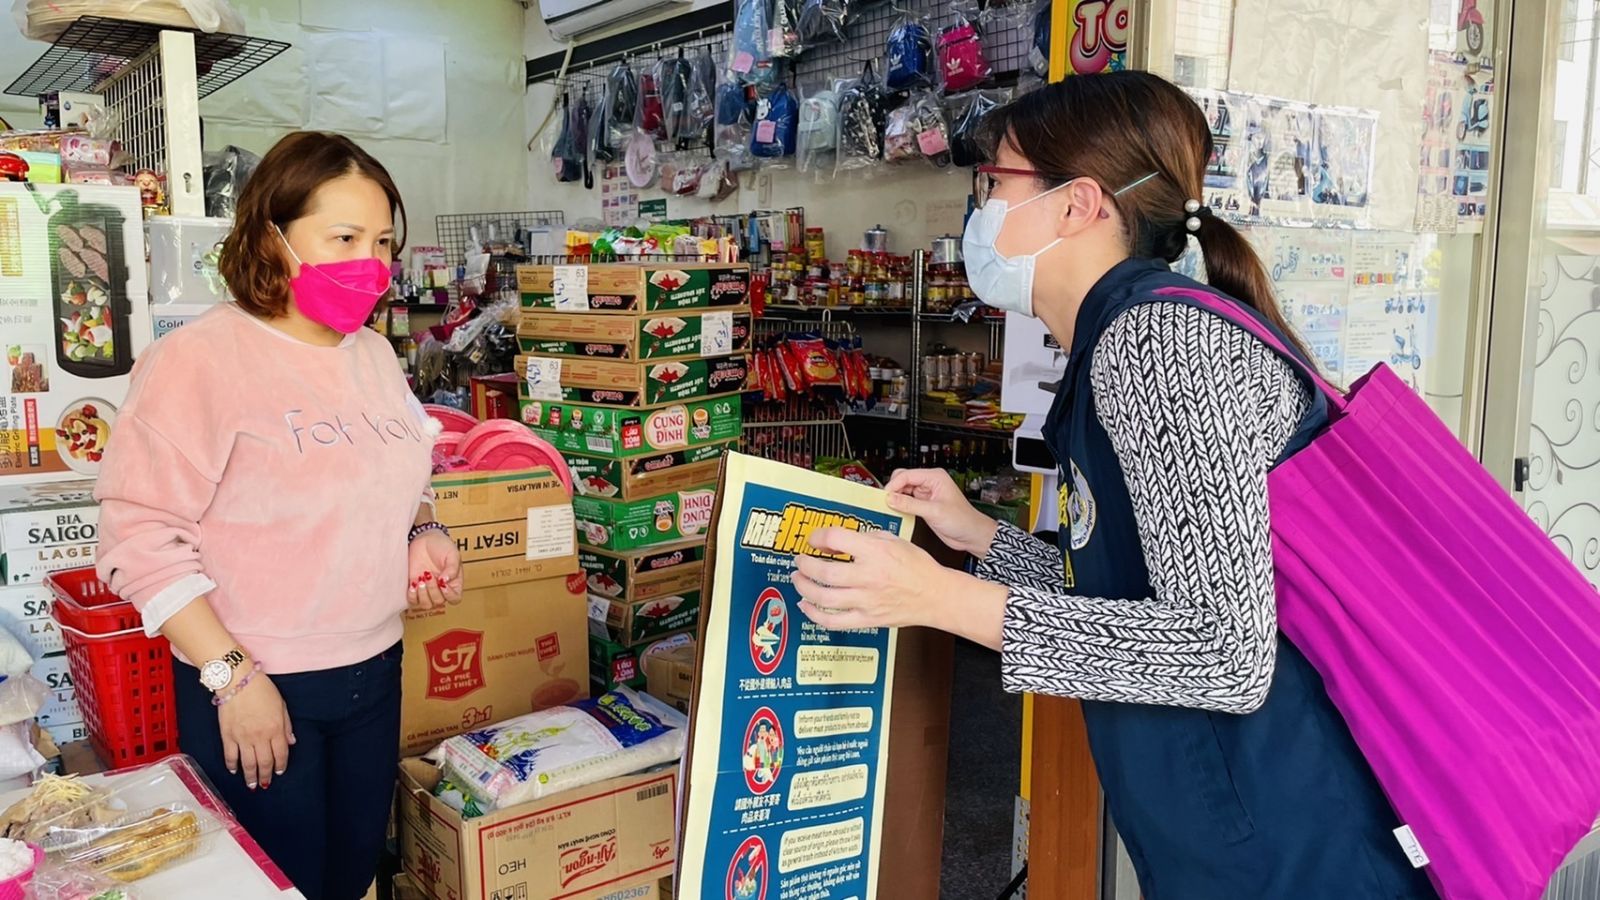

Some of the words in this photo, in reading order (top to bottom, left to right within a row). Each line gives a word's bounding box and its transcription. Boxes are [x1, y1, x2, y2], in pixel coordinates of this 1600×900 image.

[575, 268, 586, 278] 63
[653, 410, 684, 429] CUNG
[443, 490, 458, 500] NET
[508, 483, 541, 493] MALAYSIA
[56, 514, 82, 525] BIA
[28, 523, 98, 544] SAIGO
[475, 531, 519, 550] ISFAT
[457, 537, 468, 551] H
[38, 545, 98, 561] LAGE
[564, 842, 616, 876] Aji-ngon
[498, 858, 527, 876] HEO
[597, 885, 650, 900] 602367
